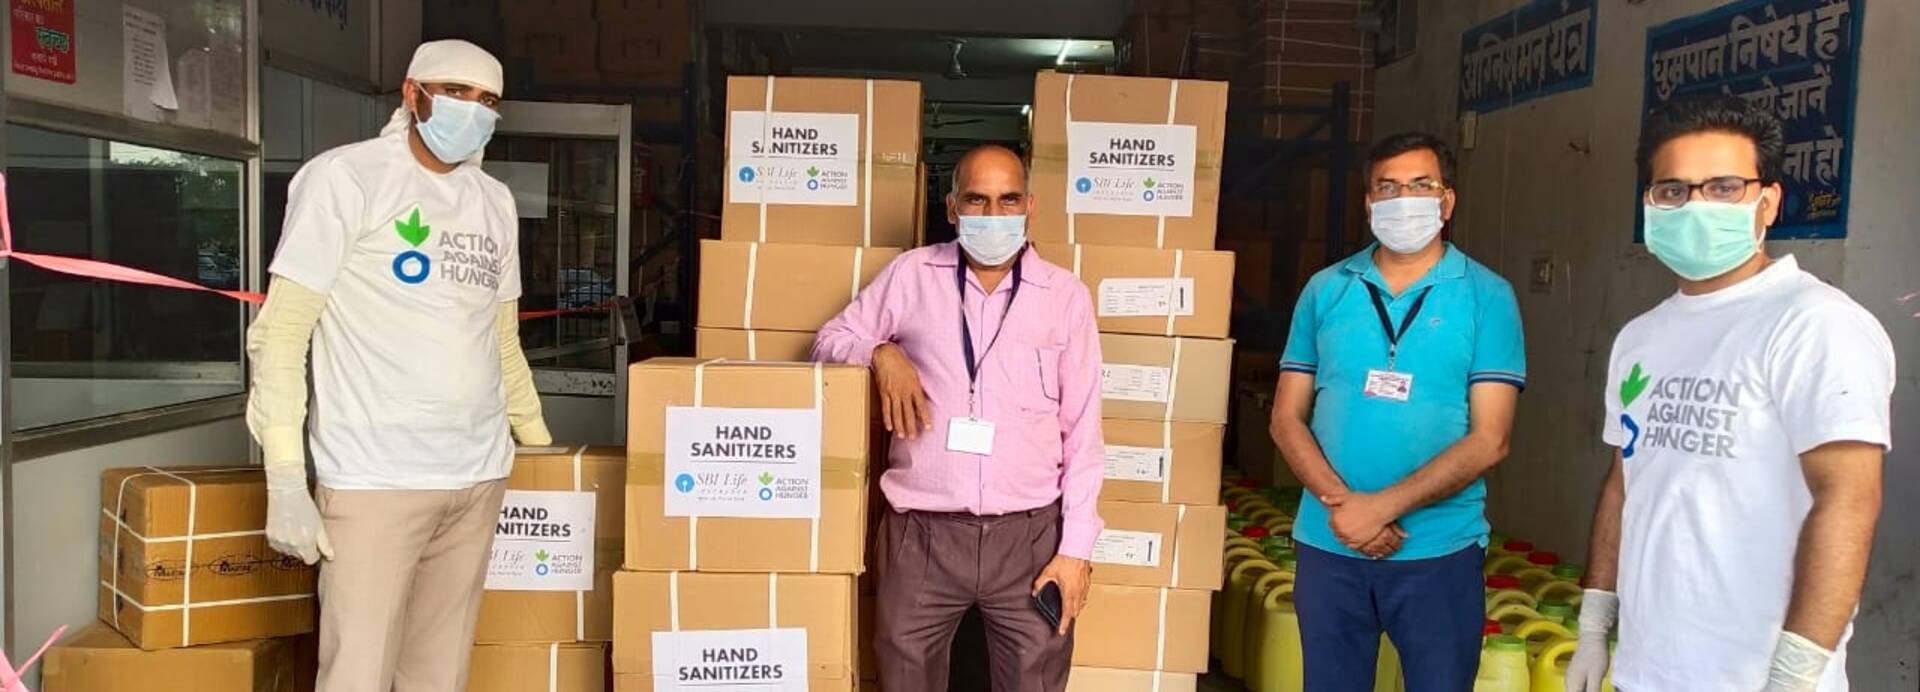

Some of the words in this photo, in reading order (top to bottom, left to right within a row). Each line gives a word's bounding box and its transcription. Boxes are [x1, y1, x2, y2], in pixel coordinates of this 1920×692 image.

[1727, 4, 1812, 73] निषेध
[772, 127, 818, 140] HAND
[1109, 138, 1156, 151] HAND
[1089, 151, 1176, 167] SANITIZERS
[443, 250, 501, 276] AGAINS
[440, 264, 499, 291] HUNG
[1648, 376, 1740, 408] ACTION
[1646, 402, 1738, 432] AGAINST
[716, 425, 772, 441] HAND
[690, 442, 797, 459] SANITIZERS
[697, 472, 719, 486] SBI
[723, 472, 748, 489] Life
[775, 478, 809, 486] ACTION
[500, 506, 549, 521] HAND
[495, 522, 571, 537] NITIZERS
[702, 648, 758, 663] HAND
[678, 664, 783, 681] SANITIZERS
